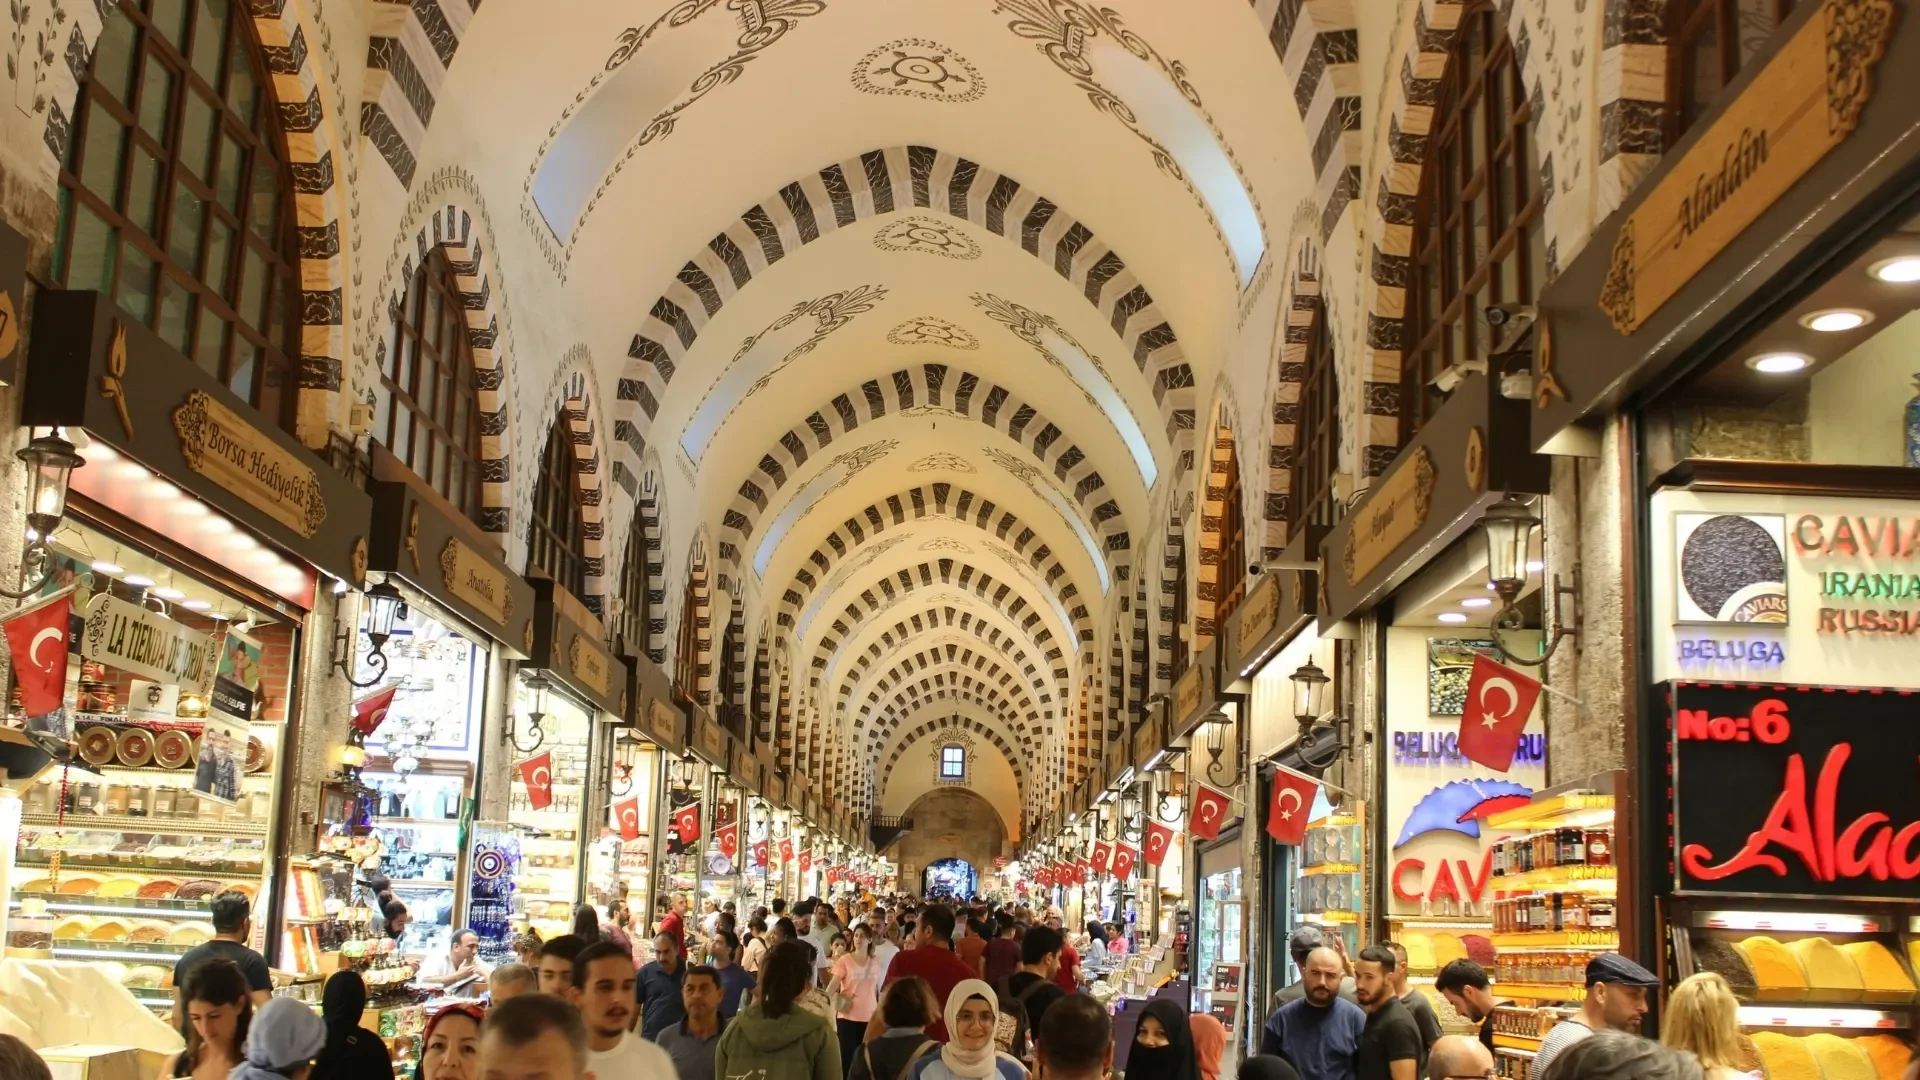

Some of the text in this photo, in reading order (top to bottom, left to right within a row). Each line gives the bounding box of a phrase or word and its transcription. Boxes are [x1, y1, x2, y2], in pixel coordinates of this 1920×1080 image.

[1674, 127, 1766, 250] Aladdin
[208, 422, 306, 507] Borsa Hediyelik
[1735, 597, 1787, 622] CAVIARS
[107, 613, 127, 656] LA
[165, 635, 182, 674] DE
[1678, 639, 1785, 663] BELUGA
[227, 697, 246, 711] SELFIE
[1677, 698, 1790, 744] No:6
[1394, 731, 1460, 760] BELUG
[1391, 838, 1511, 904] CAV
